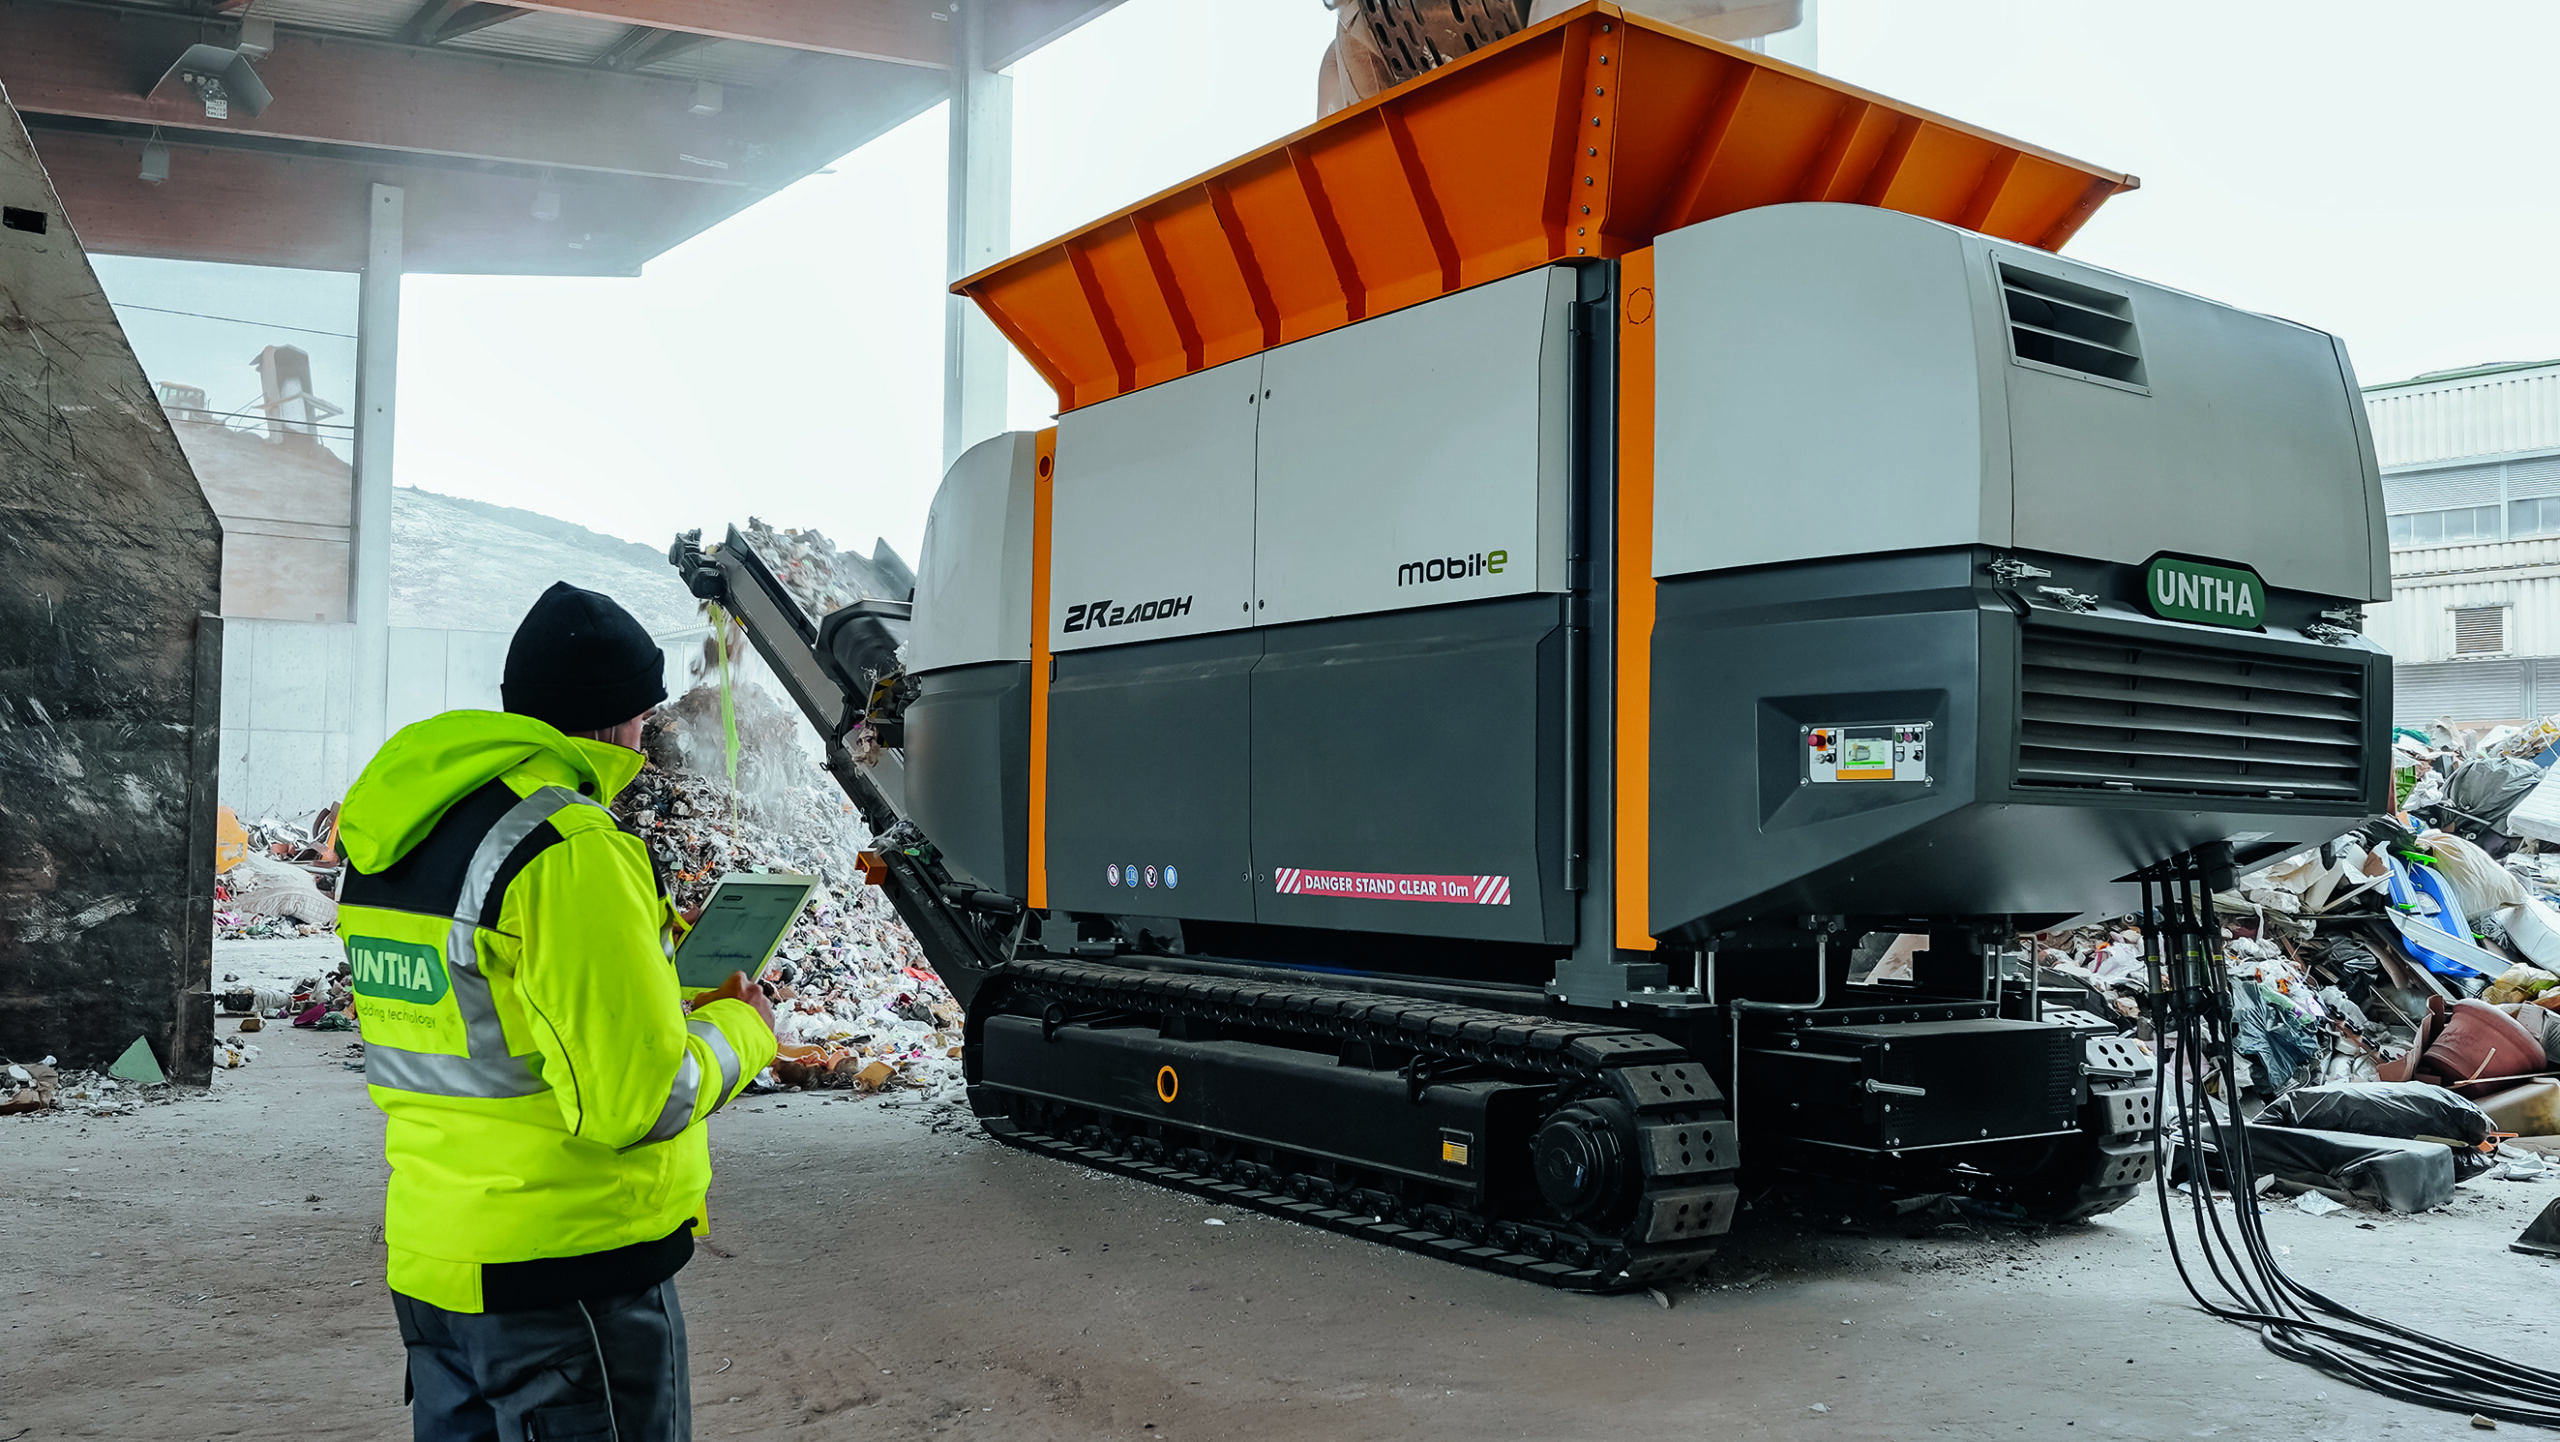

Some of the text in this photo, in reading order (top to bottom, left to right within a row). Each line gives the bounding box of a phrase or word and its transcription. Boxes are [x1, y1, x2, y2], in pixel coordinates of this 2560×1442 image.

[2156, 568, 2256, 618] UNTHA
[1305, 875, 1469, 897] DANGER STAND CLEAR 10m
[351, 947, 433, 992] UNTHA
[388, 1007, 436, 1029] technology
